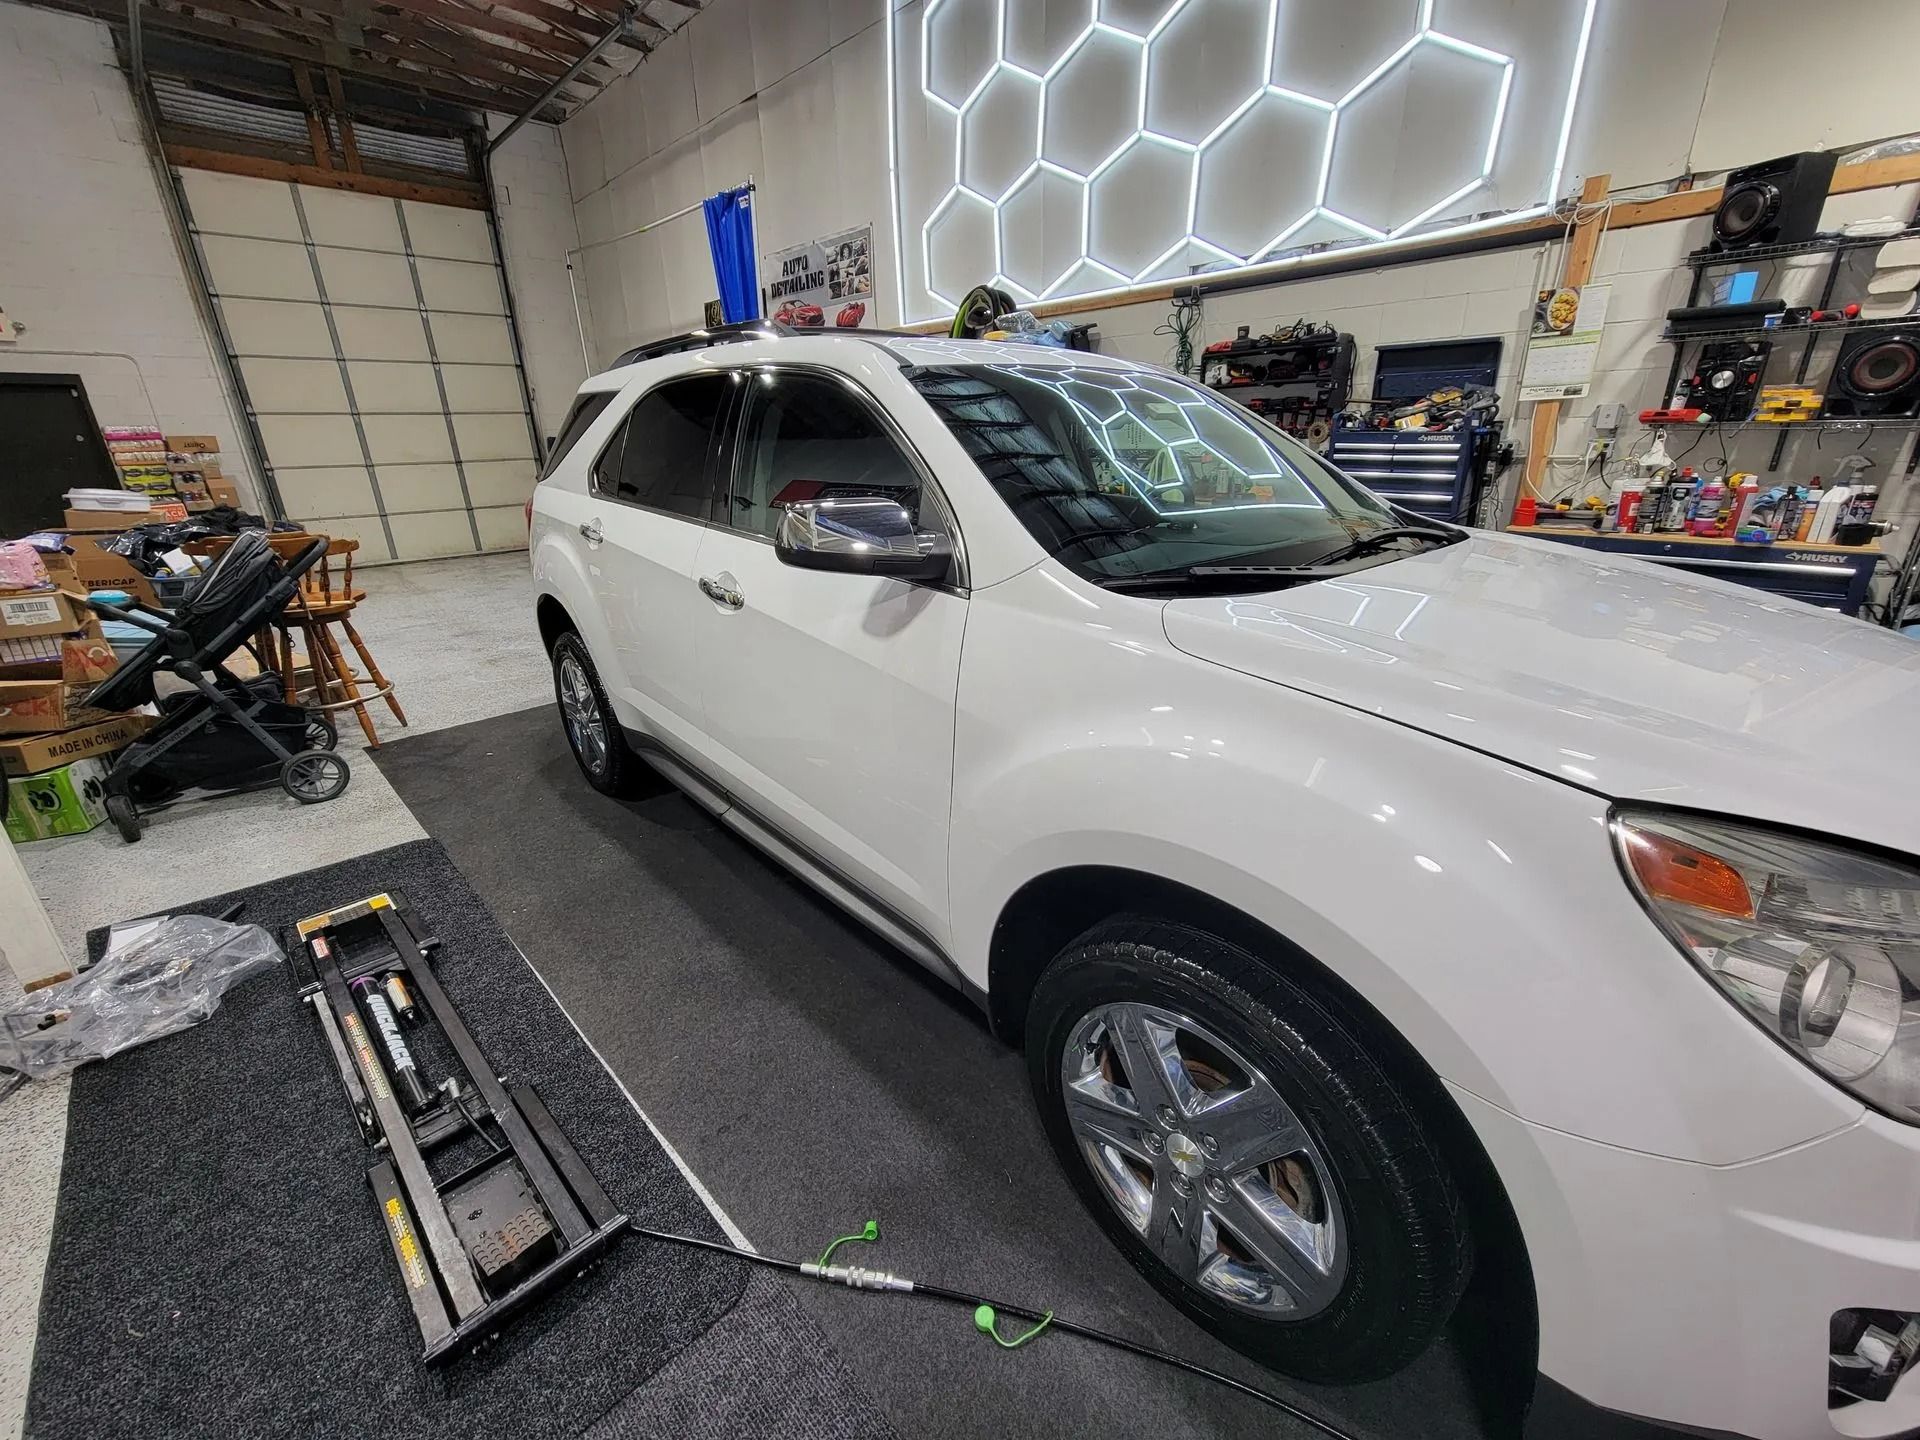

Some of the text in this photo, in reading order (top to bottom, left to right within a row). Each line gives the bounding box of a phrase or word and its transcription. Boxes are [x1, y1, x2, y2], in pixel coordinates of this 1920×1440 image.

[782, 254, 808, 277] AUTO
[771, 270, 824, 299] DETAILING
[1801, 553, 1848, 563] HUSKY
[87, 578, 136, 587] BERICAP
[48, 728, 129, 758] MADE IN CHINA
[366, 994, 416, 1073] QUICKJACK
